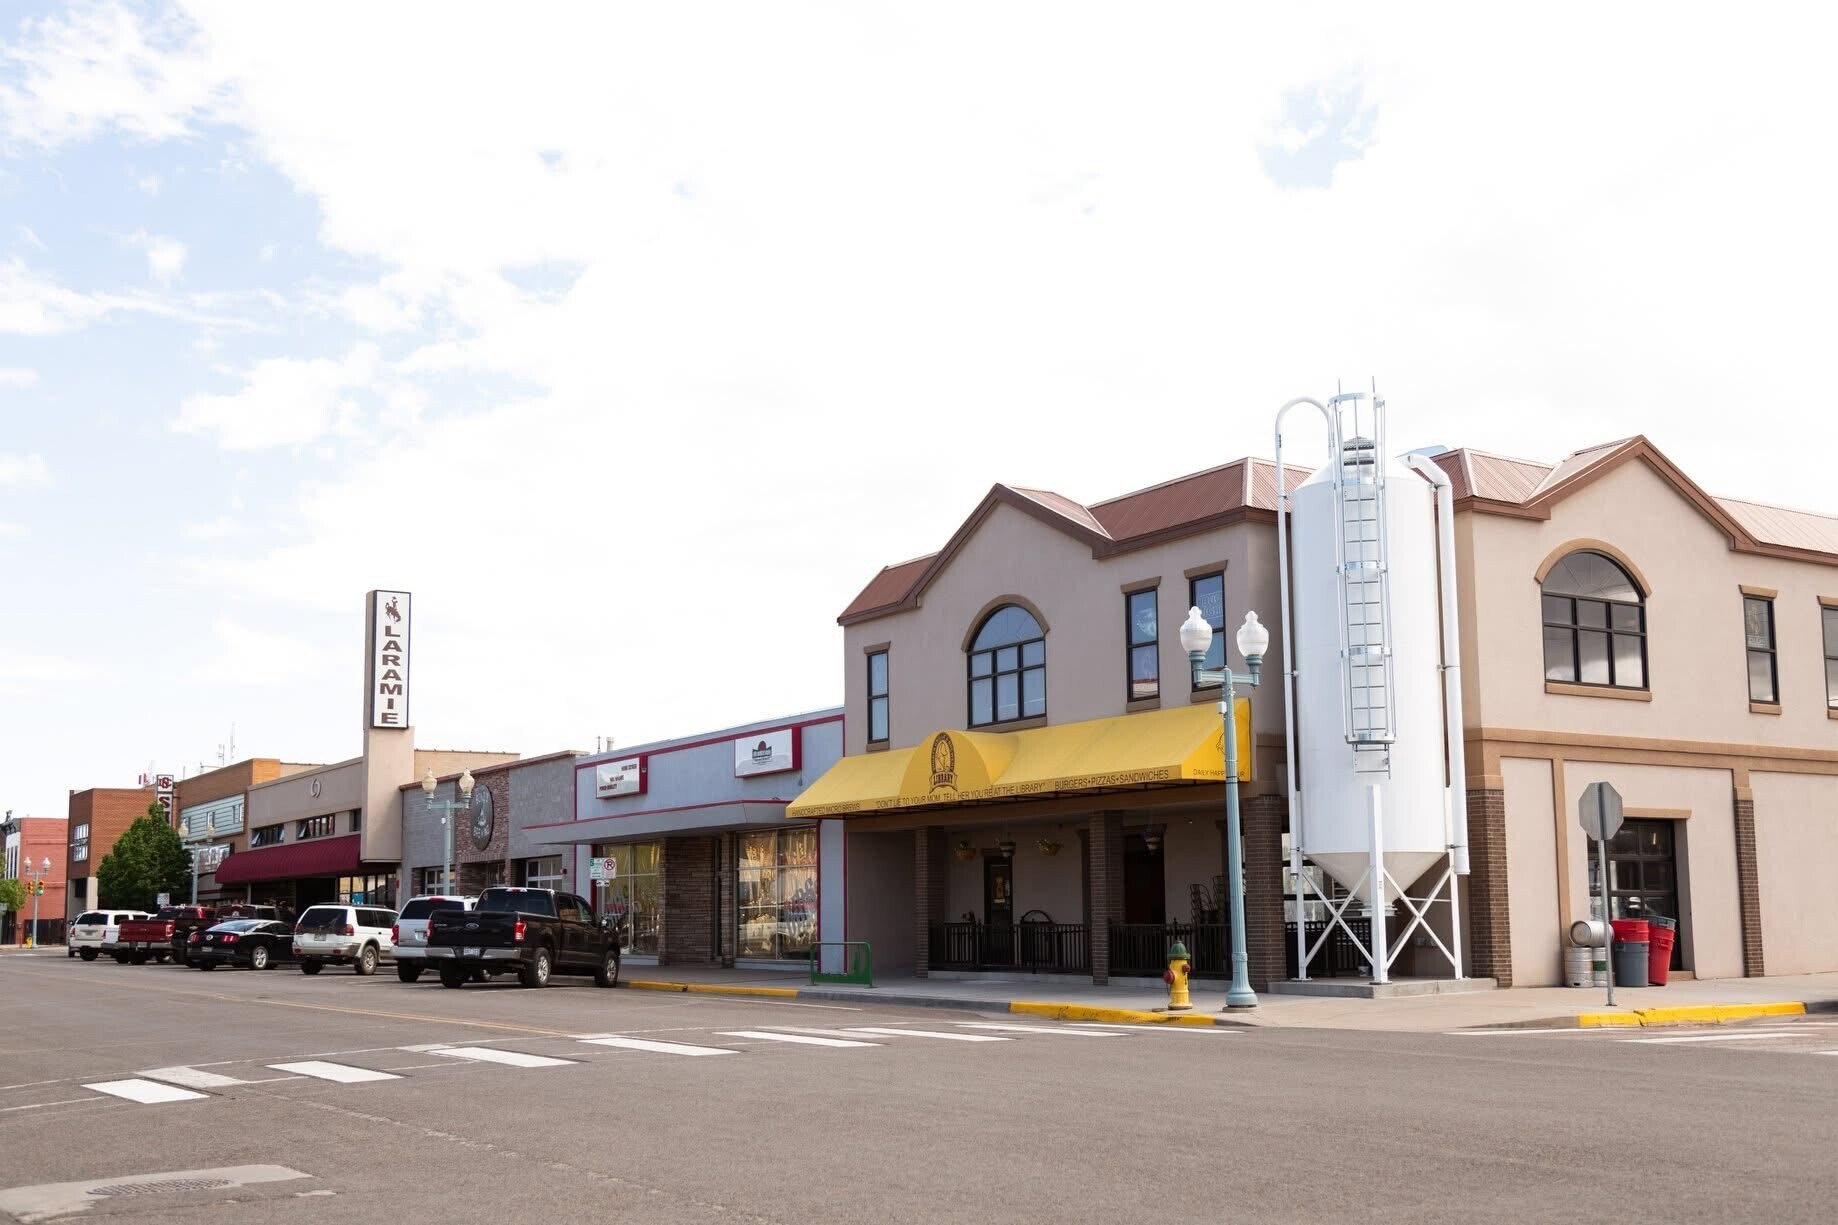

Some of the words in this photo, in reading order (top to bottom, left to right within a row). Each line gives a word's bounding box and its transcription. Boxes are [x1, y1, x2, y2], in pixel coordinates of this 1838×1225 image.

[379, 625, 402, 724] LARAMIE
[933, 773, 953, 786] LIBRARY
[1210, 769, 1225, 777] HAPP
[902, 797, 909, 805] TO
[910, 795, 926, 805] YOUR
[958, 791, 969, 800] HER
